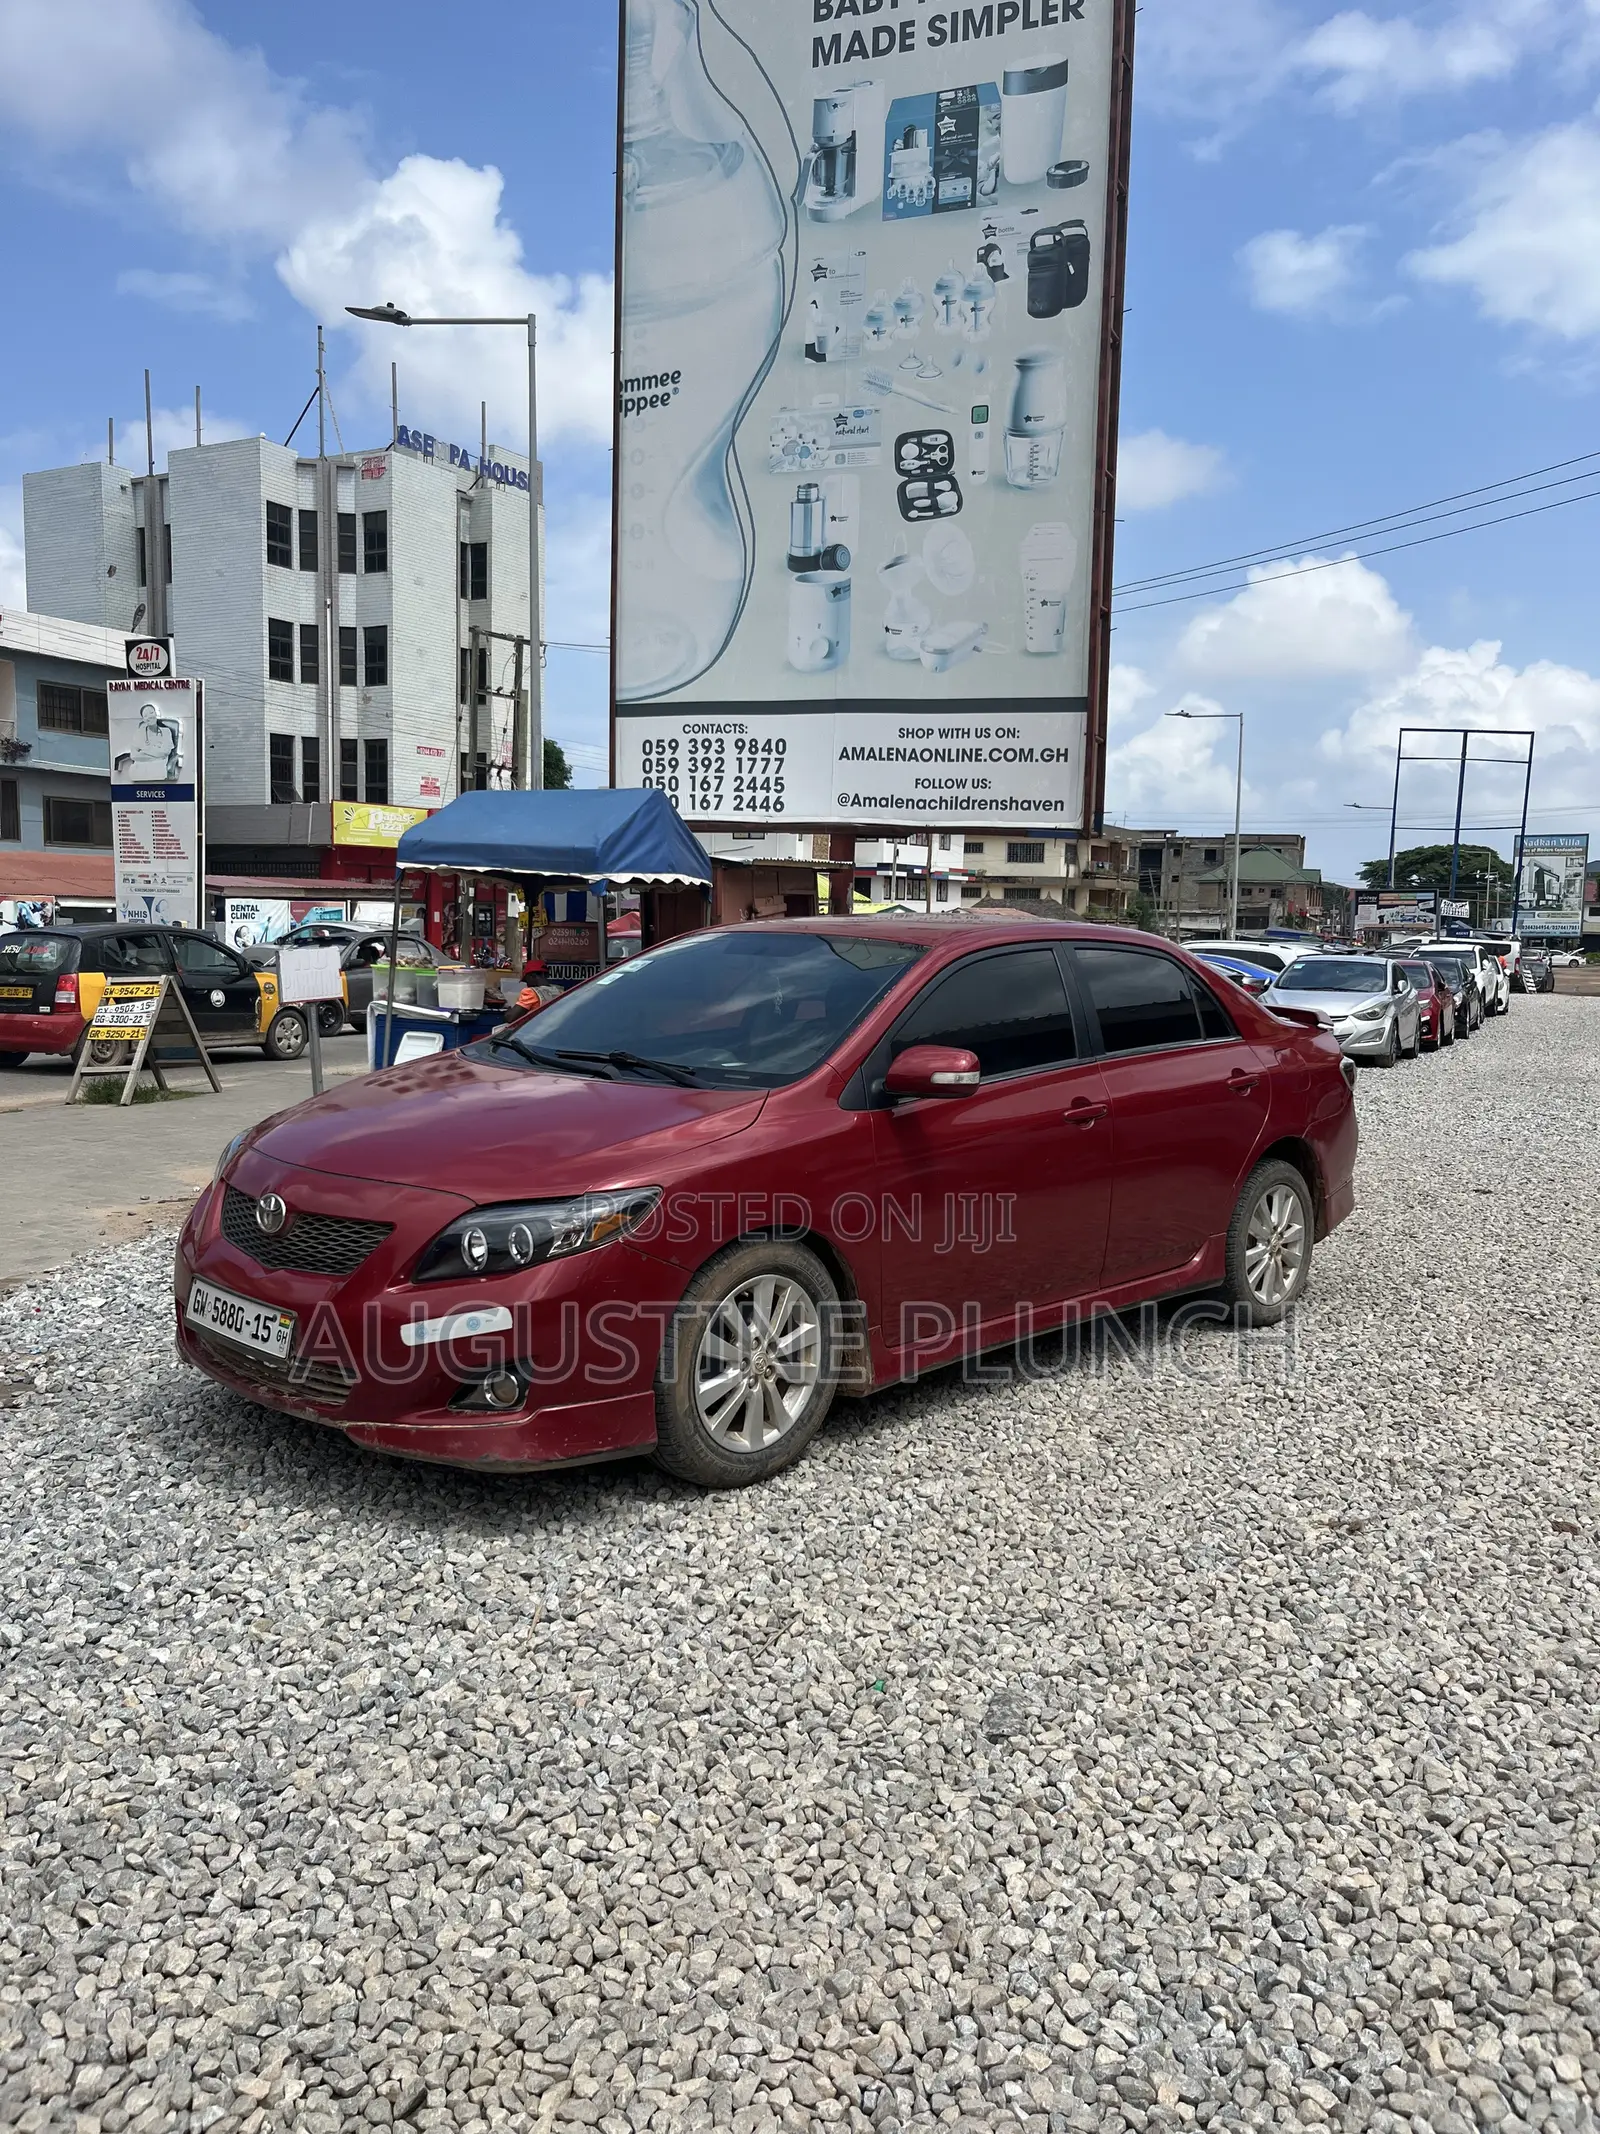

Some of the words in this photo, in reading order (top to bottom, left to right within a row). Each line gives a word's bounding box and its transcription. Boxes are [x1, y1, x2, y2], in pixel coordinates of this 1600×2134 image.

[813, 0, 899, 23] BAB
[812, 20, 916, 68] MADE
[926, 0, 1086, 48] SIMPLER
[479, 456, 530, 492] HOUS
[136, 646, 160, 661] 24/7
[135, 662, 161, 671] HOSPITAL
[109, 681, 132, 692] RAYAN
[134, 680, 163, 691] MEDICAL
[164, 679, 190, 690] CENTRE
[682, 724, 748, 735] CONTACTS:
[898, 727, 934, 739] SHOP
[937, 728, 970, 738] WITH
[975, 728, 991, 739] US
[995, 727, 1020, 739] ON:
[642, 739, 679, 756] 059
[688, 738, 725, 755] 393
[734, 738, 786, 755] 9840
[838, 747, 1069, 762] AMALENAONLINE.COM.GH
[642, 757, 679, 774] 059
[688, 757, 725, 774] 392
[736, 757, 785, 774] 1777
[642, 776, 679, 792] 050
[690, 776, 724, 792] 167
[733, 776, 785, 794] 2445
[915, 778, 967, 790] FOLLOW
[972, 779, 992, 790] US:
[136, 790, 165, 798] SERVICES
[690, 794, 724, 811] 167
[733, 795, 785, 813] 2446
[837, 792, 1065, 812] @Amalenachildrenshaven
[128, 910, 148, 919] NHIS
[230, 904, 260, 912] DENTAL
[230, 912, 256, 920] CLINIC
[119, 986, 155, 996] 9547-21
[109, 1015, 143, 1024] 3300-22
[105, 1029, 140, 1038] 5250-21
[193, 1288, 208, 1317] GW
[211, 1296, 275, 1343] 5880-15
[276, 1329, 288, 1345] GH
